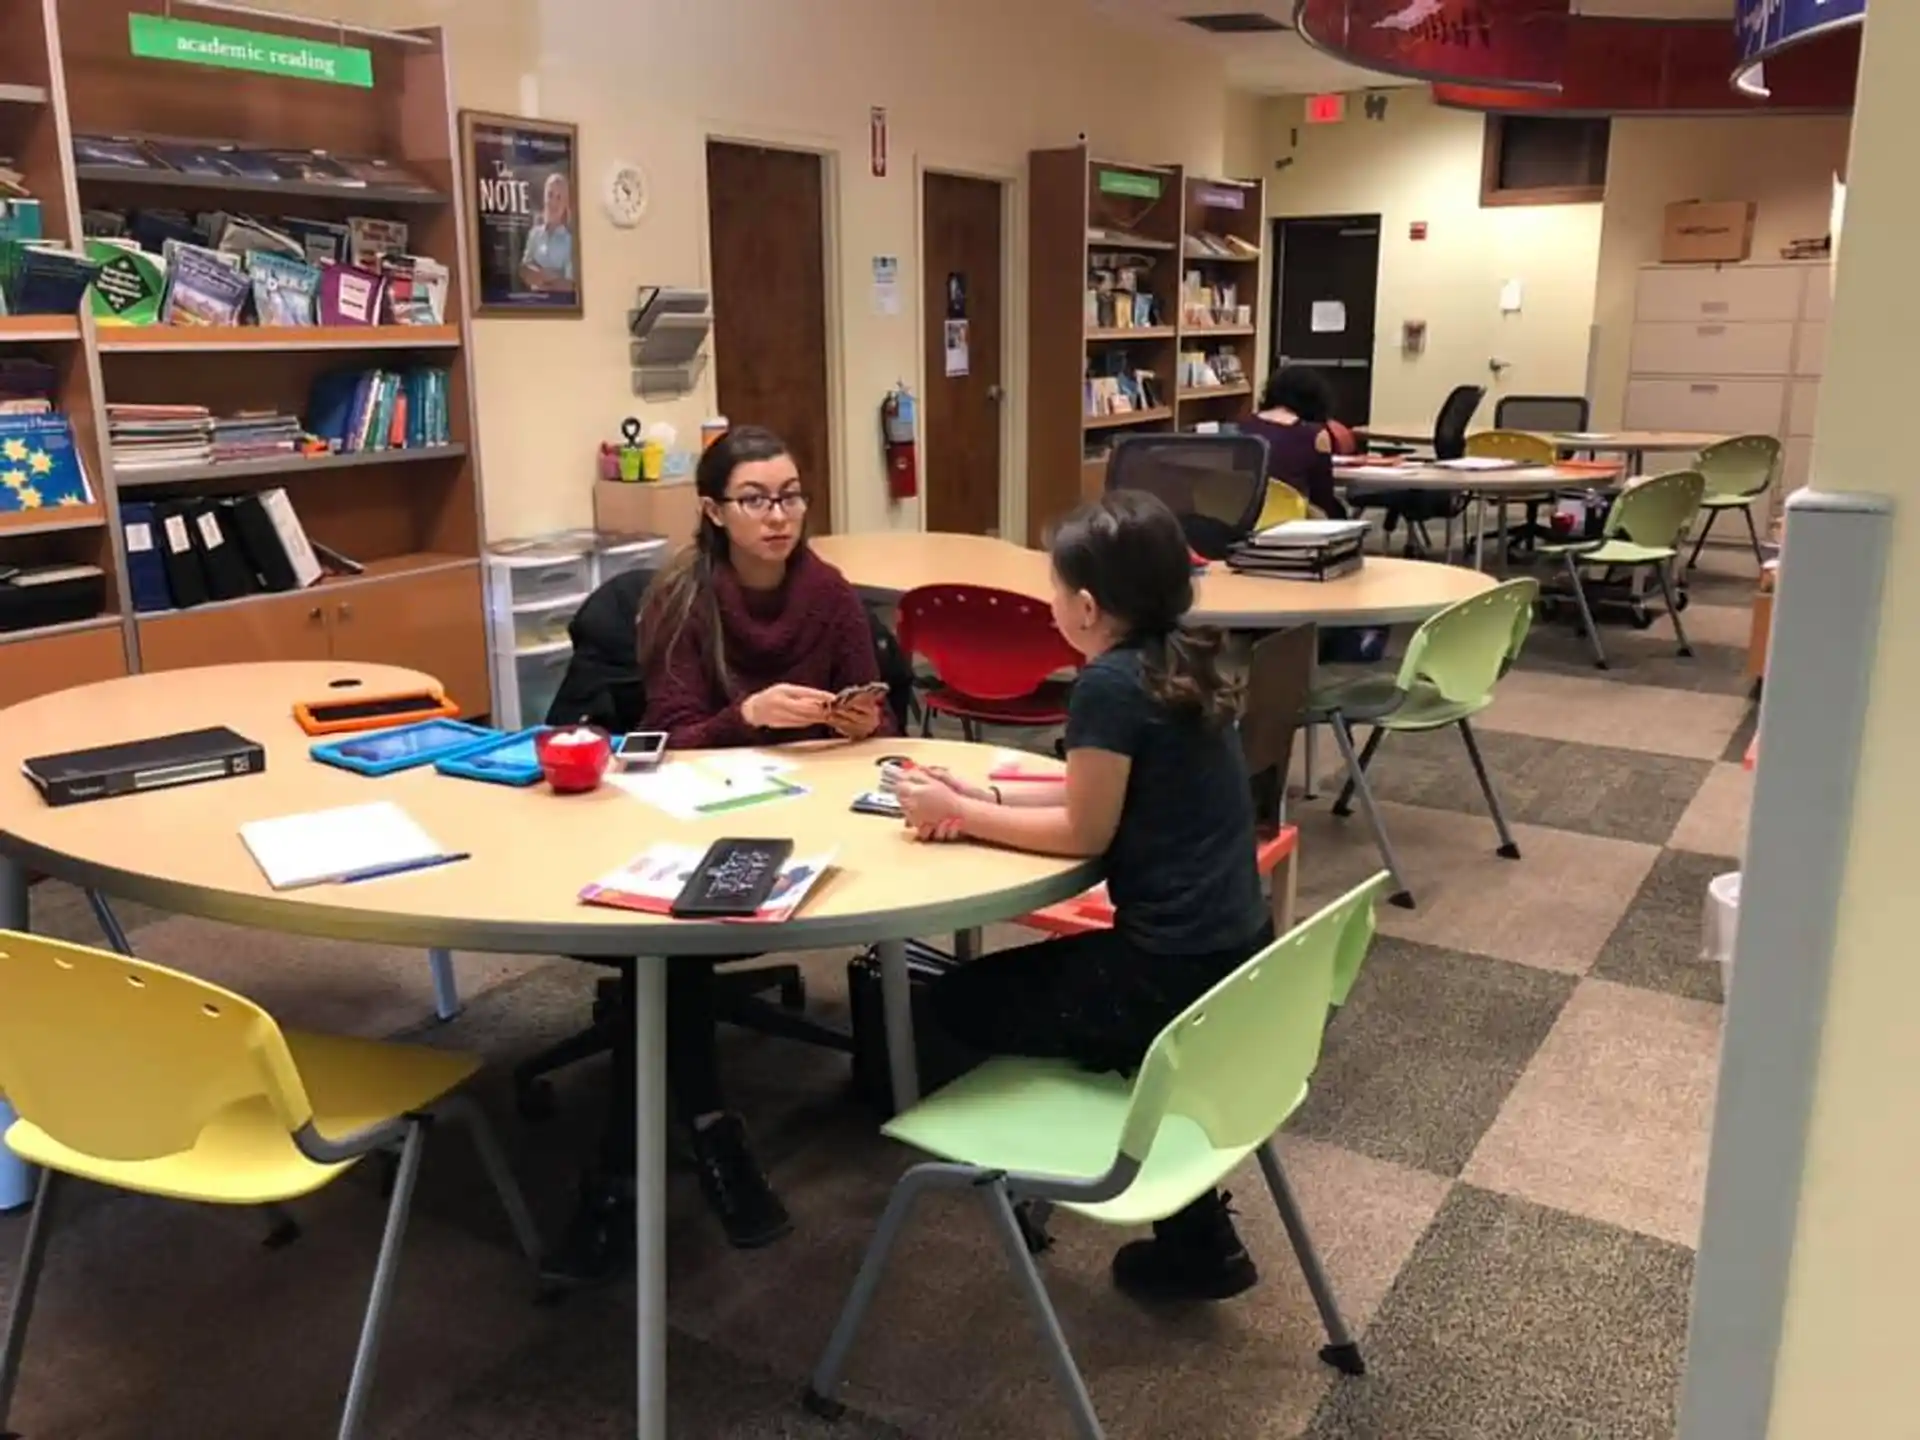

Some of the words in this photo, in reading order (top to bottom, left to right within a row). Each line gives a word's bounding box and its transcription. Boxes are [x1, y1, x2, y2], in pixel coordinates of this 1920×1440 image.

[176, 36, 266, 62] academic
[269, 49, 336, 77] reading
[479, 177, 532, 214] NOTE
